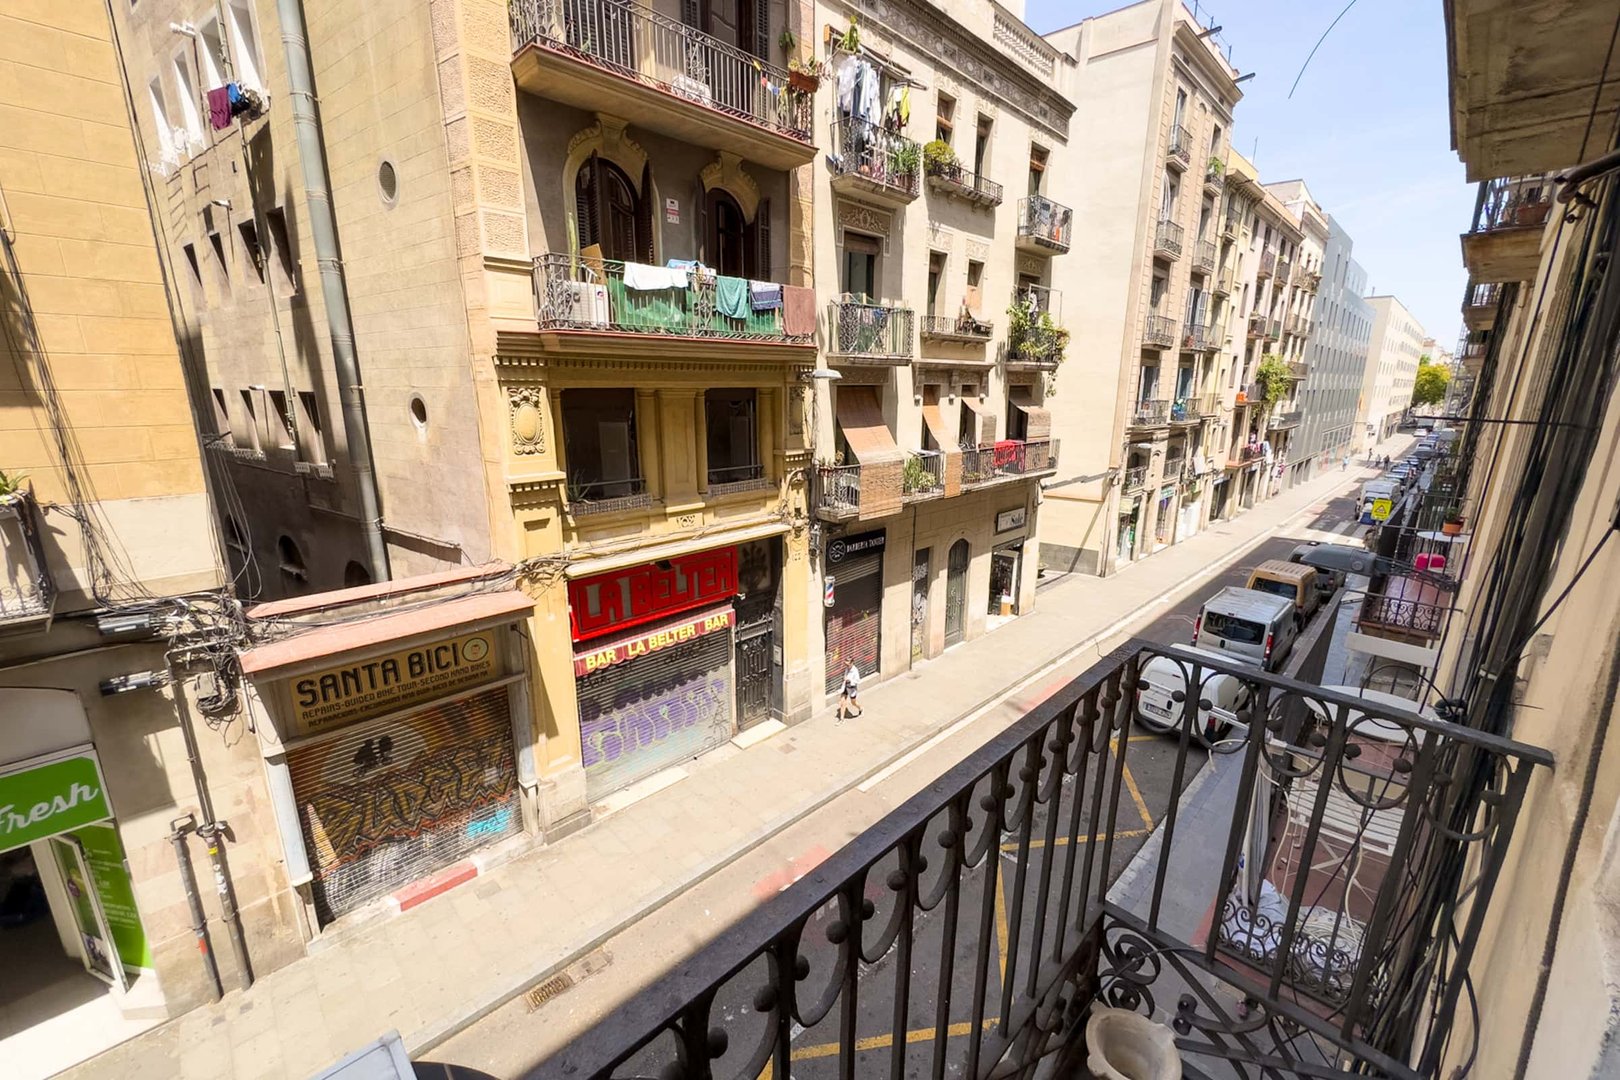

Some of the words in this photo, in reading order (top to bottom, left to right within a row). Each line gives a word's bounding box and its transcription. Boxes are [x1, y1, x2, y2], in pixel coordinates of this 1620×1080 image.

[579, 580, 624, 630] LA
[631, 556, 732, 616] BELTER
[296, 658, 401, 708] SANTA
[407, 642, 459, 679] BICI
[586, 650, 616, 670] BAR
[627, 639, 645, 656] LA
[650, 624, 696, 649] BELTER
[704, 614, 728, 631] BAR
